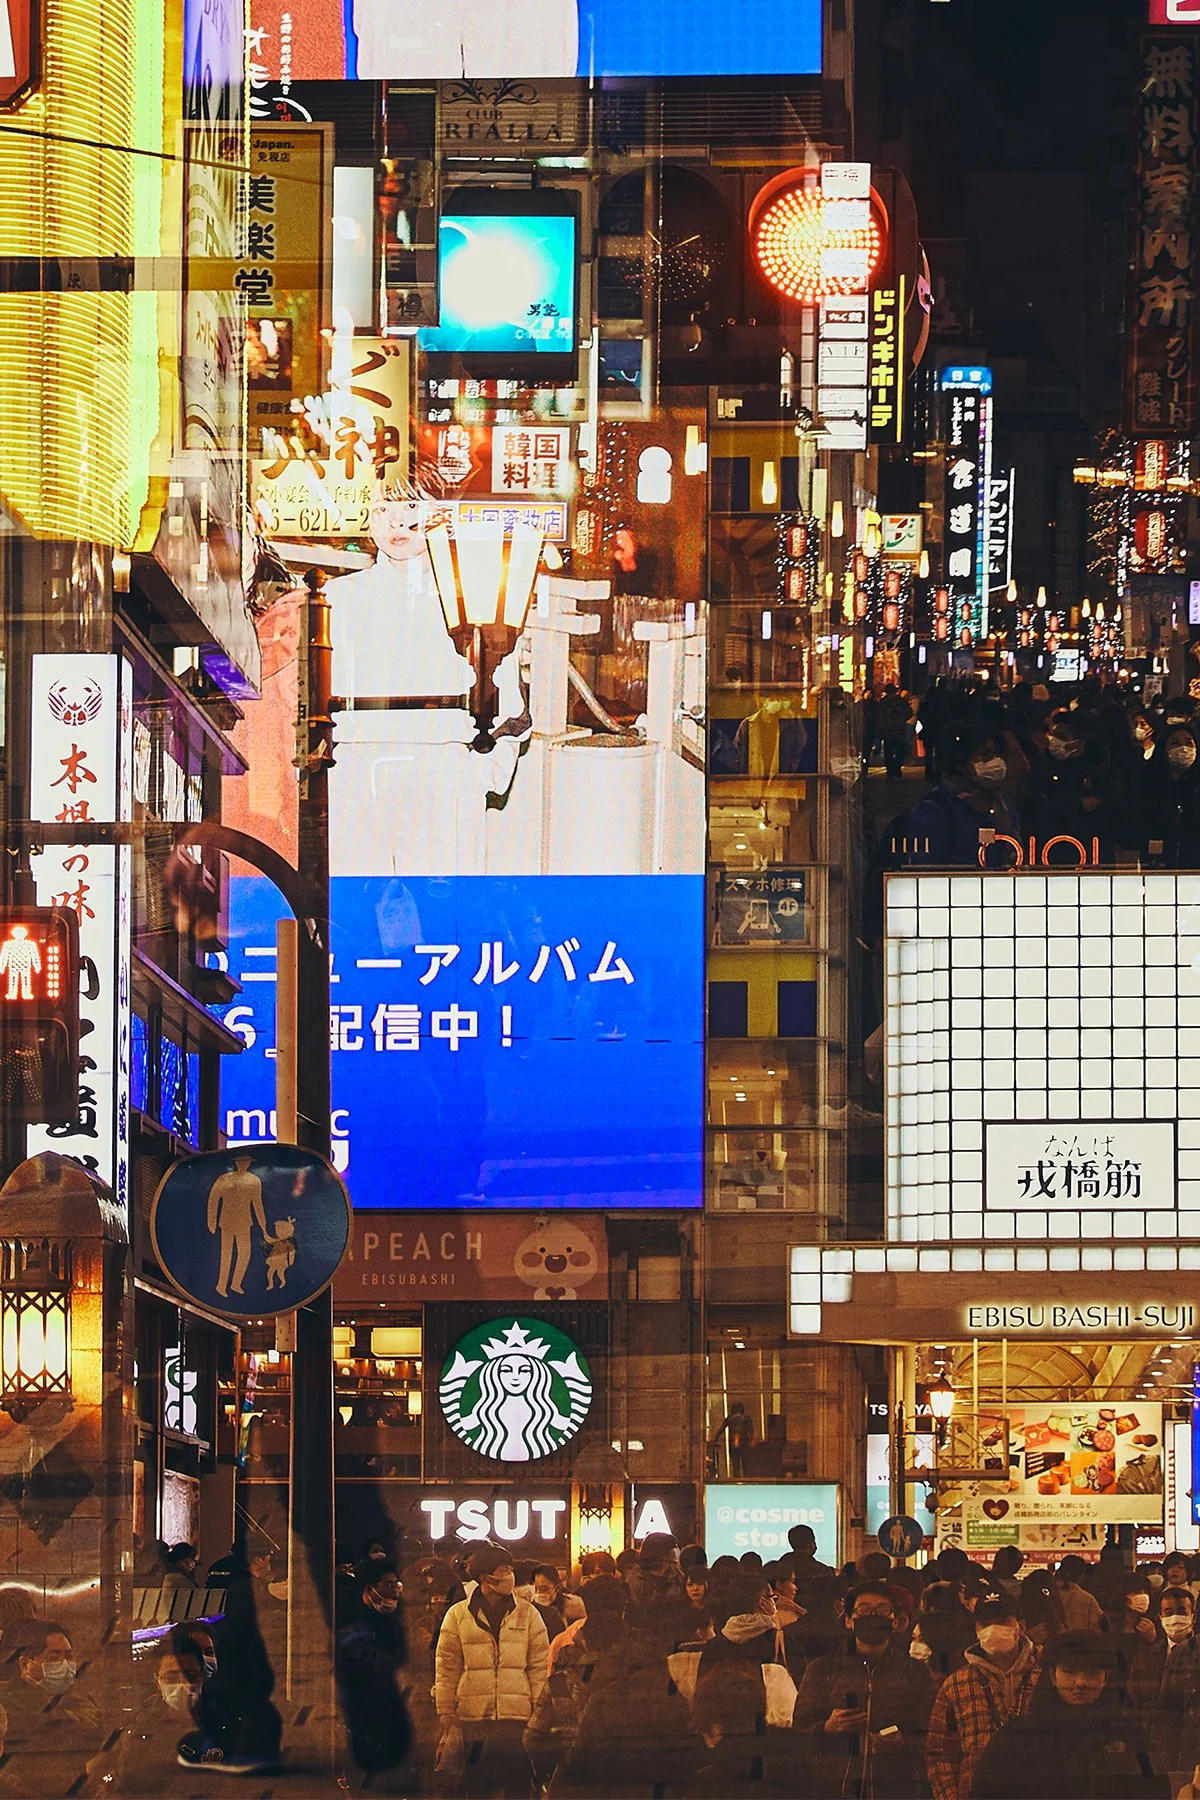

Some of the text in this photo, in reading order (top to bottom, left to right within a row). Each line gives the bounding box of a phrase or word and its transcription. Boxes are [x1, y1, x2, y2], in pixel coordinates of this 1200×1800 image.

[503, 432, 561, 460] 韓国
[725, 877, 802, 892] スマホ修理
[780, 901, 796, 911] 4F
[1044, 1135, 1116, 1157] なんば
[1018, 1159, 1142, 1199] 戎橋筋
[361, 1273, 456, 1286] EBISUBASHI
[968, 1306, 1045, 1328] EBISU
[420, 1500, 673, 1540] TSUTA
[717, 1507, 826, 1524] @cosme
